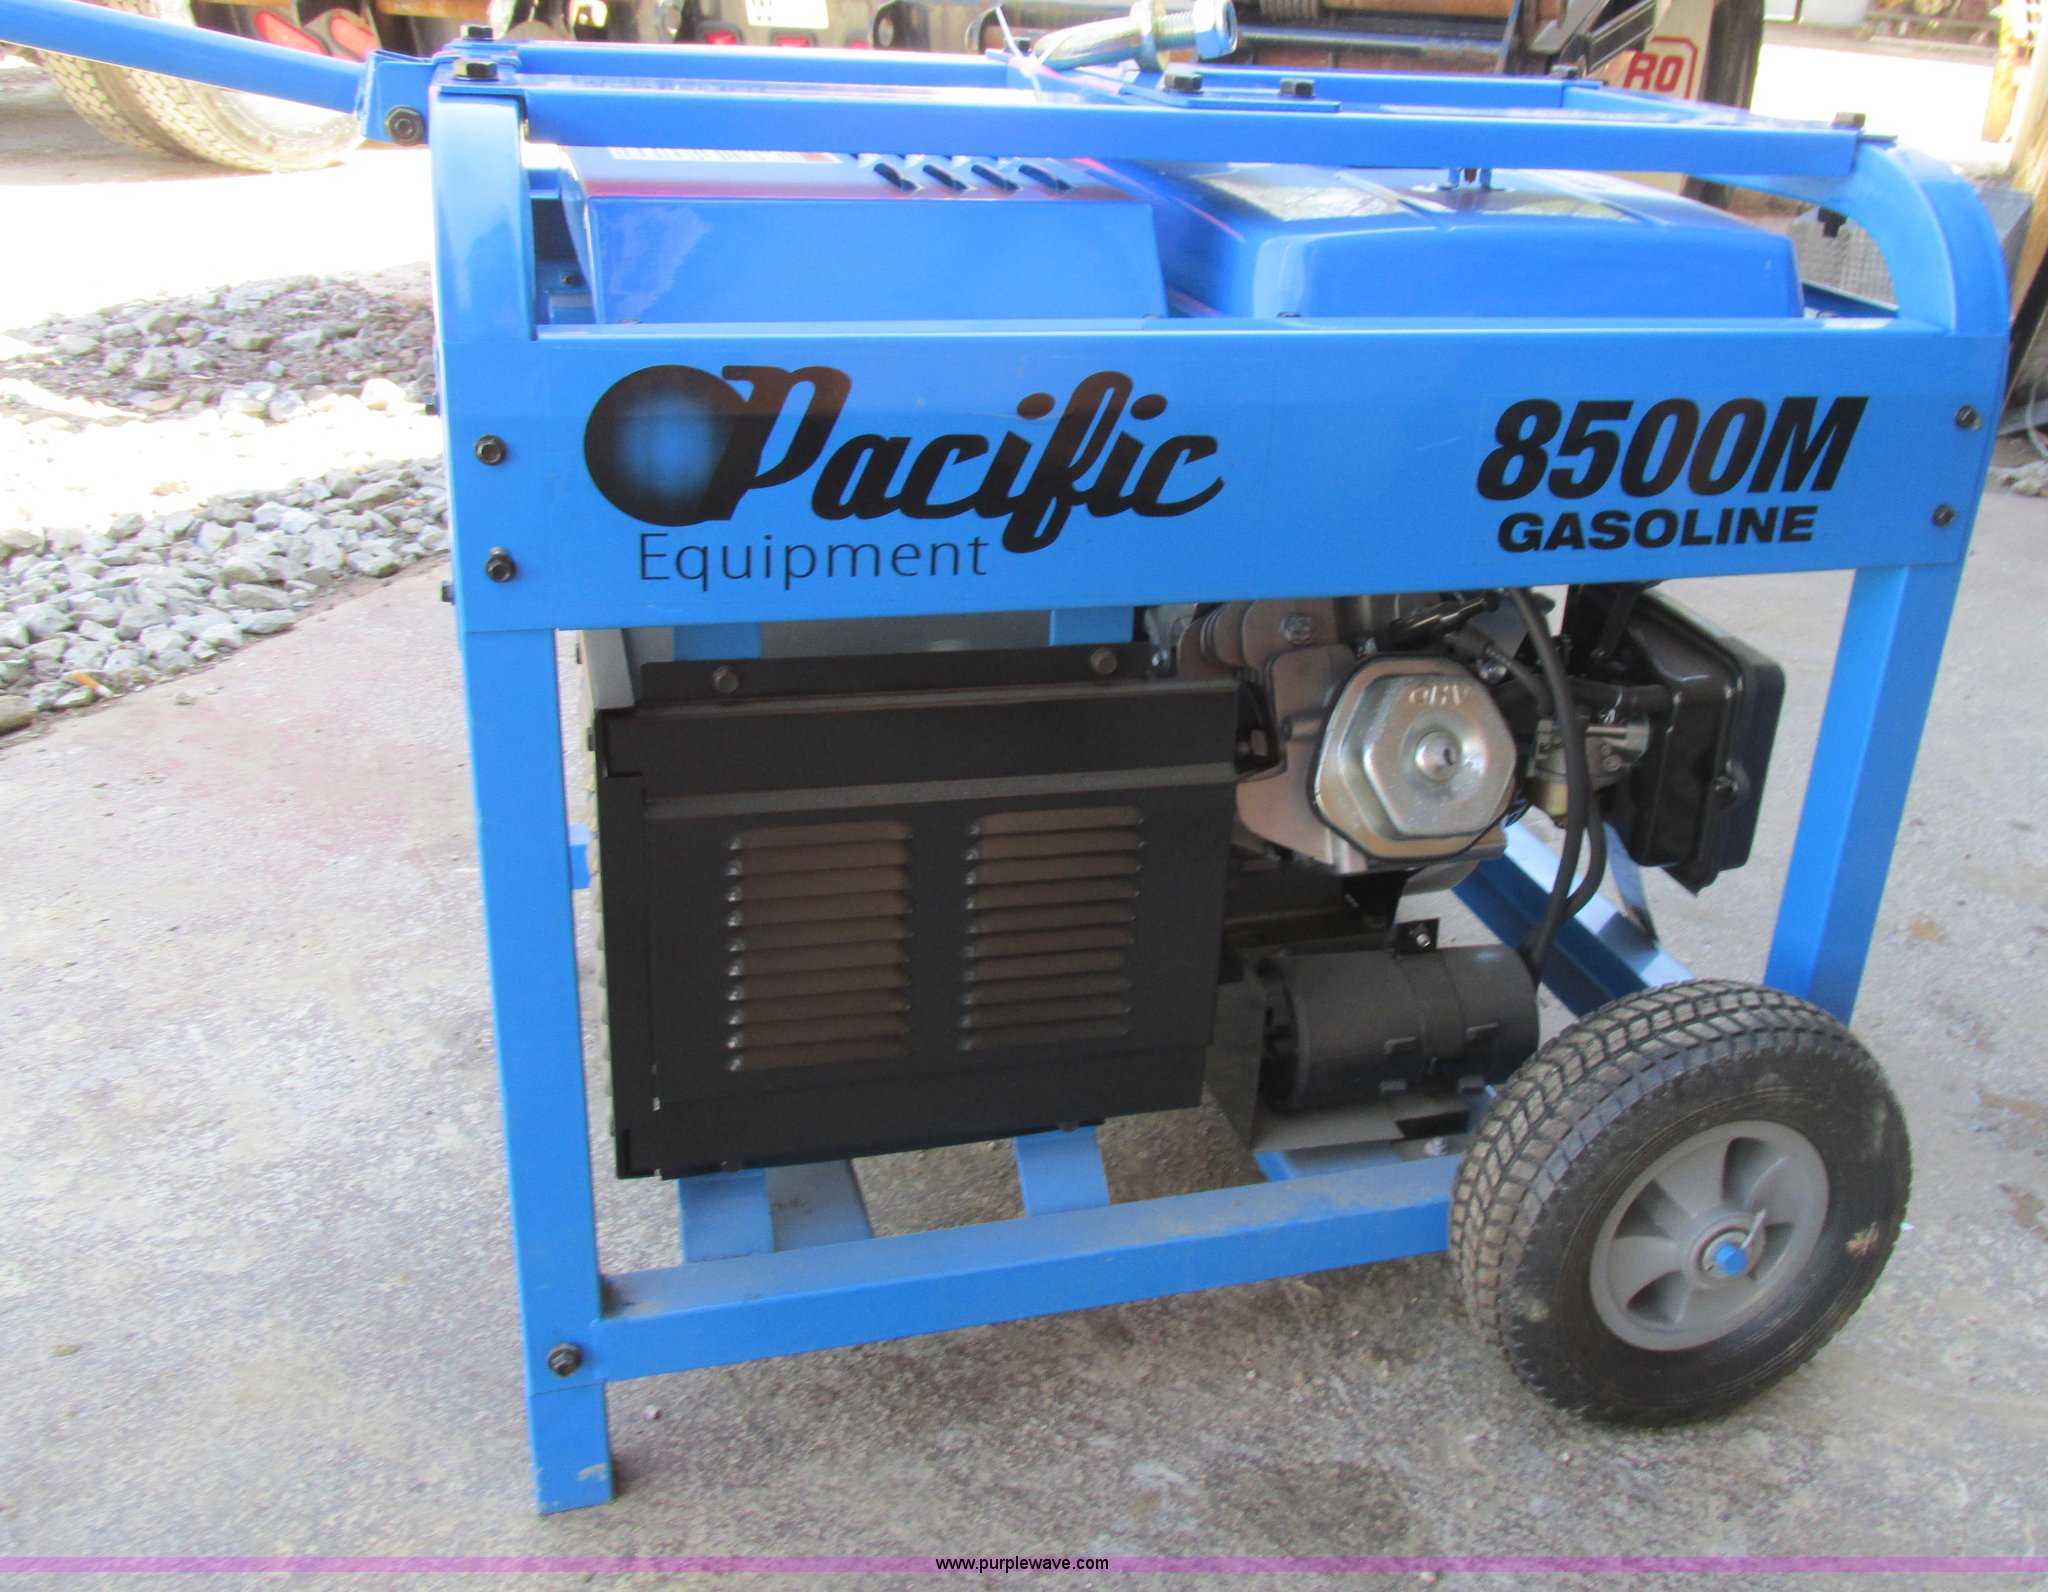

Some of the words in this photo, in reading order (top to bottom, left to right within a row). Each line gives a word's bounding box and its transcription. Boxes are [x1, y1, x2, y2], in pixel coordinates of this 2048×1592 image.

[706, 366, 1225, 553] Pacific
[1477, 396, 1869, 501] 8500M
[639, 533, 988, 591] Equipment
[1499, 505, 1818, 553] GASOLINE
